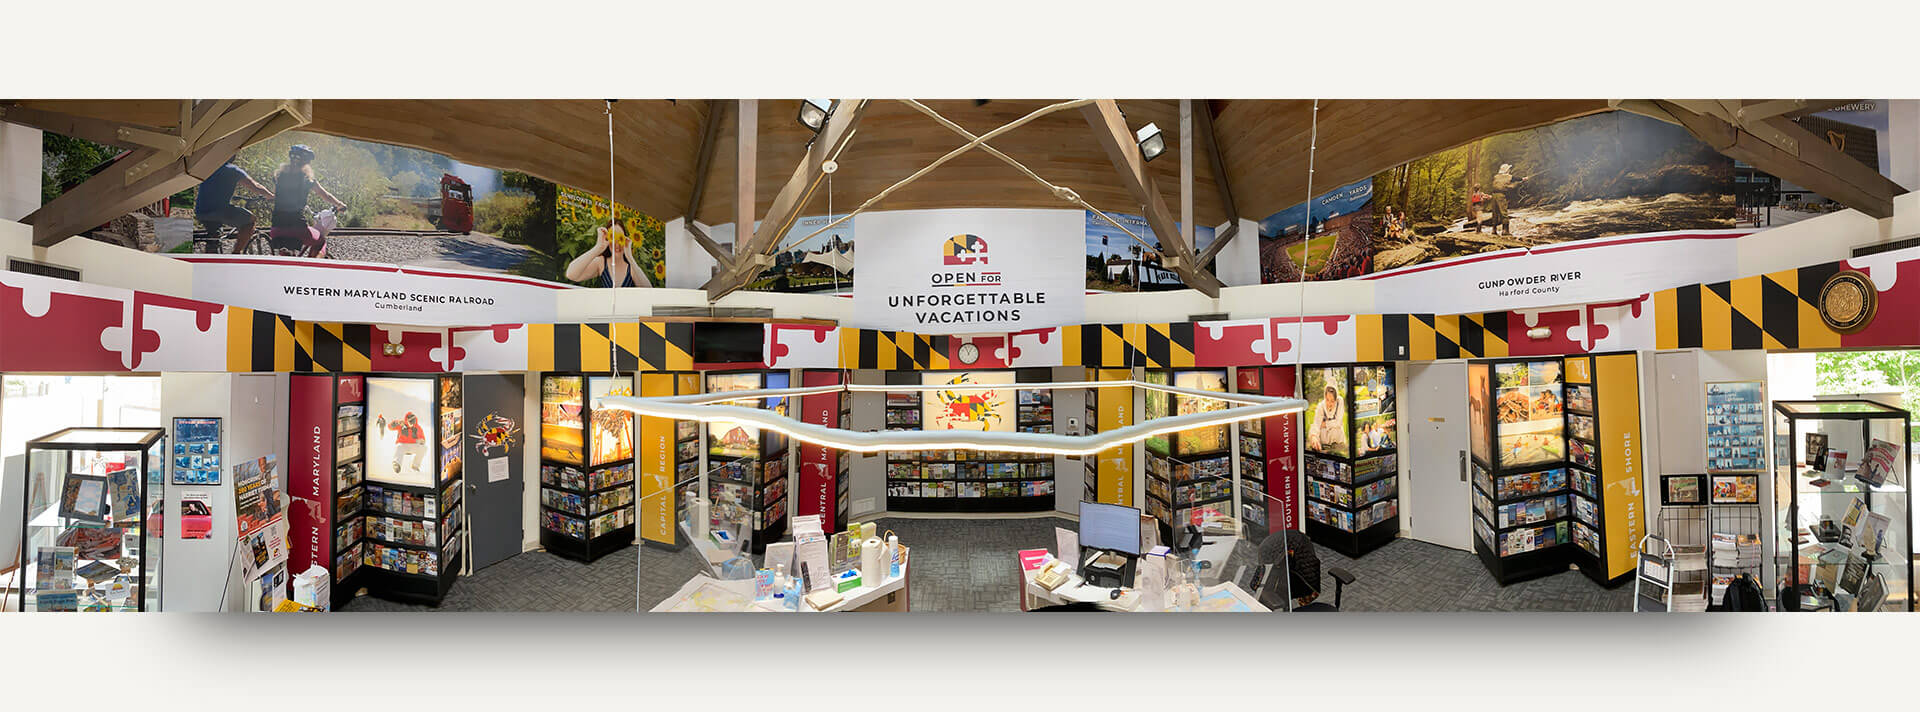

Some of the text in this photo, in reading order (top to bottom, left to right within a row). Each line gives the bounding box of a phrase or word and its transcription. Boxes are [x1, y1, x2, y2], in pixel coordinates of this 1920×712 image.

[931, 272, 1001, 284] OPEN FOR
[1478, 271, 1582, 290] GUNPOWDER RIVER
[283, 285, 495, 306] WESTERN MARYLAND SCENIC RALROAD
[1499, 285, 1560, 297] Harford County
[374, 302, 423, 312] Cumberland
[888, 292, 1046, 308] UNFORGETTABLE
[915, 309, 1021, 324] VACATIONS
[311, 426, 321, 567] STERN MARYLAND
[1284, 475, 1292, 529] SOUTHERN
[1624, 432, 1637, 559] EASTERN SHORE
